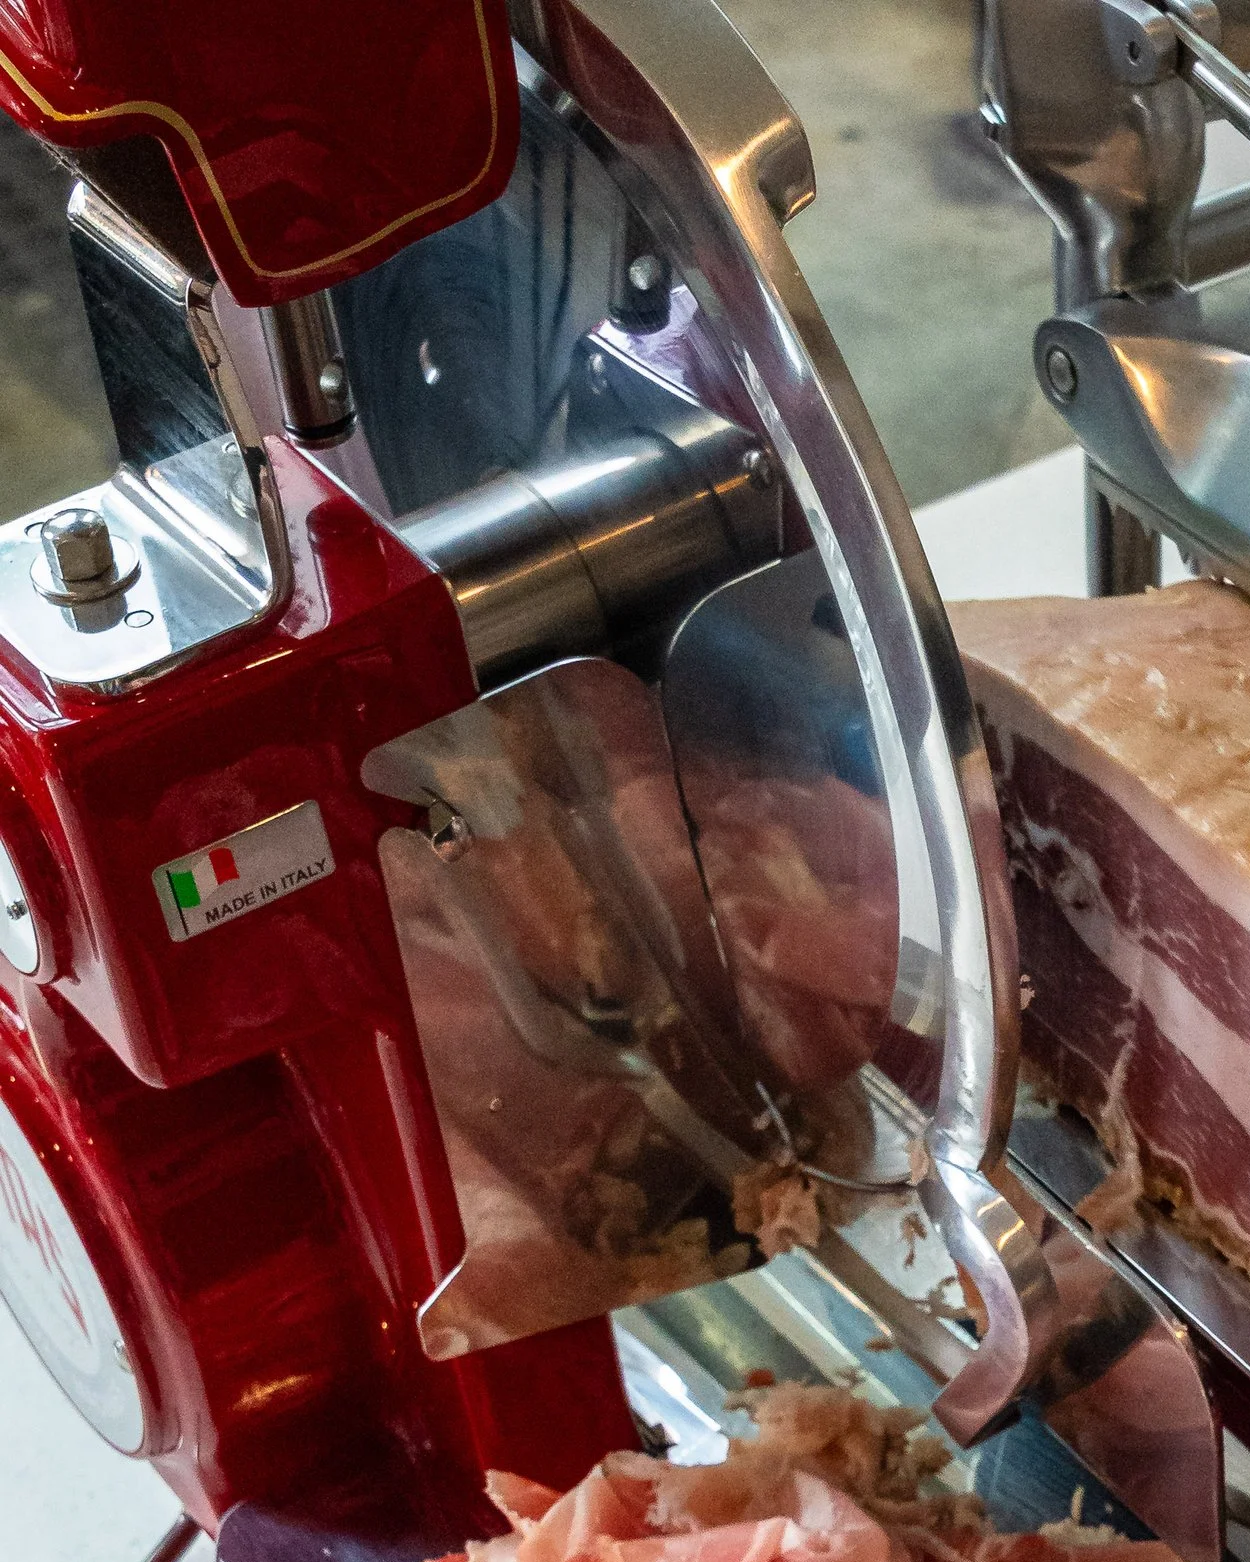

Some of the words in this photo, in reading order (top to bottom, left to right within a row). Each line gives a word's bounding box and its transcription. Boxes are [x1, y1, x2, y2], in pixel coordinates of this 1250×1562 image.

[204, 891, 255, 924] MADE
[260, 881, 278, 900] IN
[282, 857, 327, 891] ITALY
